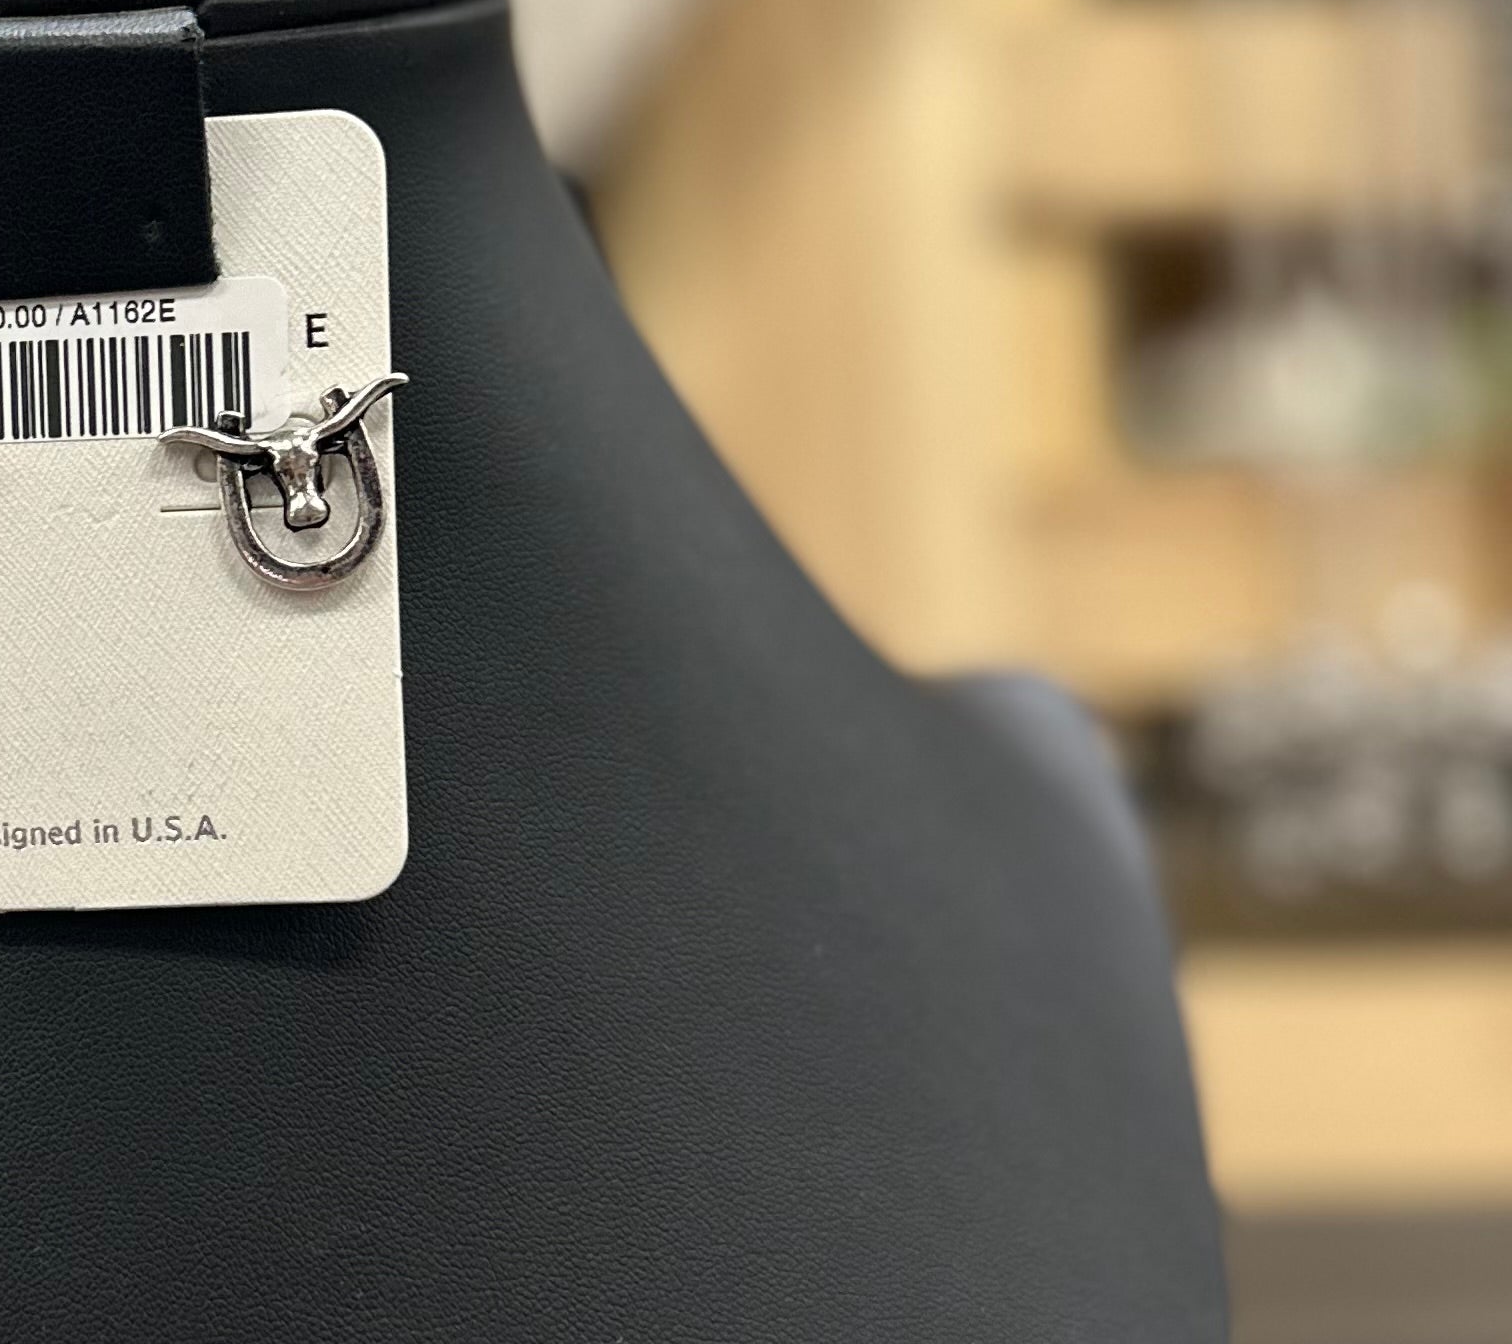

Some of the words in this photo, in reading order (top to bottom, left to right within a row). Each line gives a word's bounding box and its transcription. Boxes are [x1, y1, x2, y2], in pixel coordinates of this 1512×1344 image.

[70, 298, 176, 326] A1162E
[93, 818, 120, 844] in
[131, 814, 228, 843] U.S.A.
